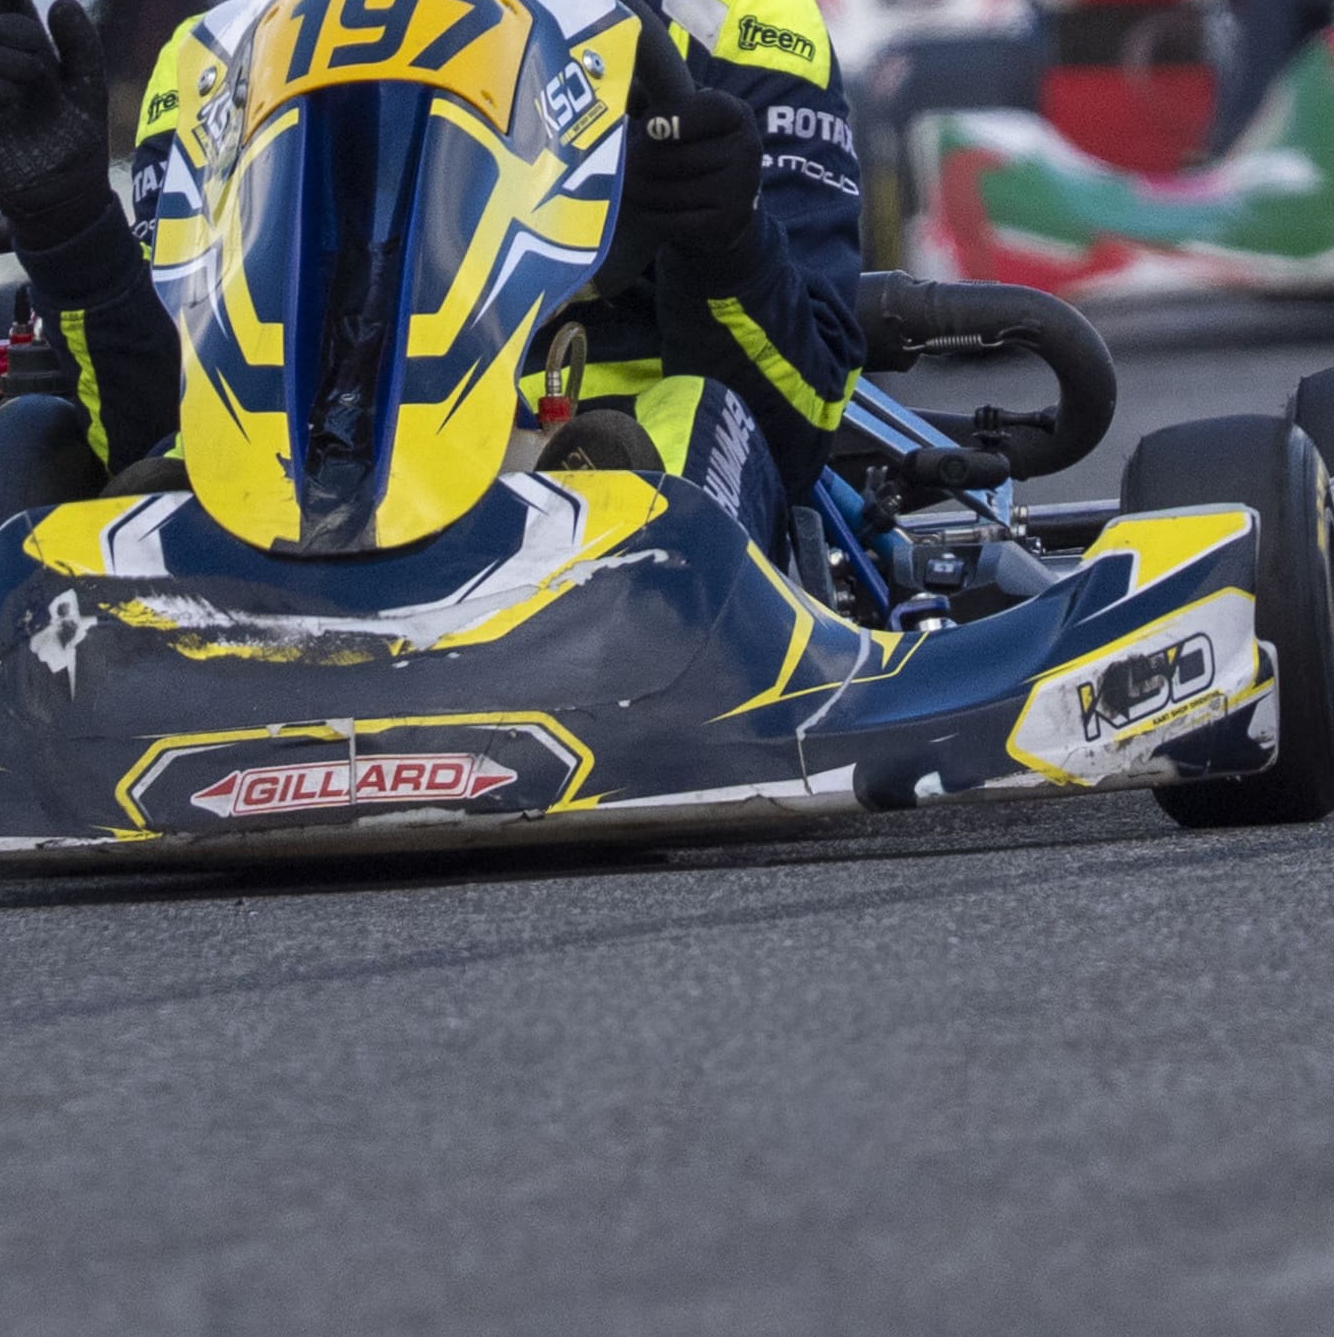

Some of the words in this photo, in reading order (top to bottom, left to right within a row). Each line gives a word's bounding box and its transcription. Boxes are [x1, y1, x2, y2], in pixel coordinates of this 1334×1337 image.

[740, 16, 815, 61] freem
[767, 105, 858, 160] ROTAX
[243, 763, 465, 807] GILLARD
